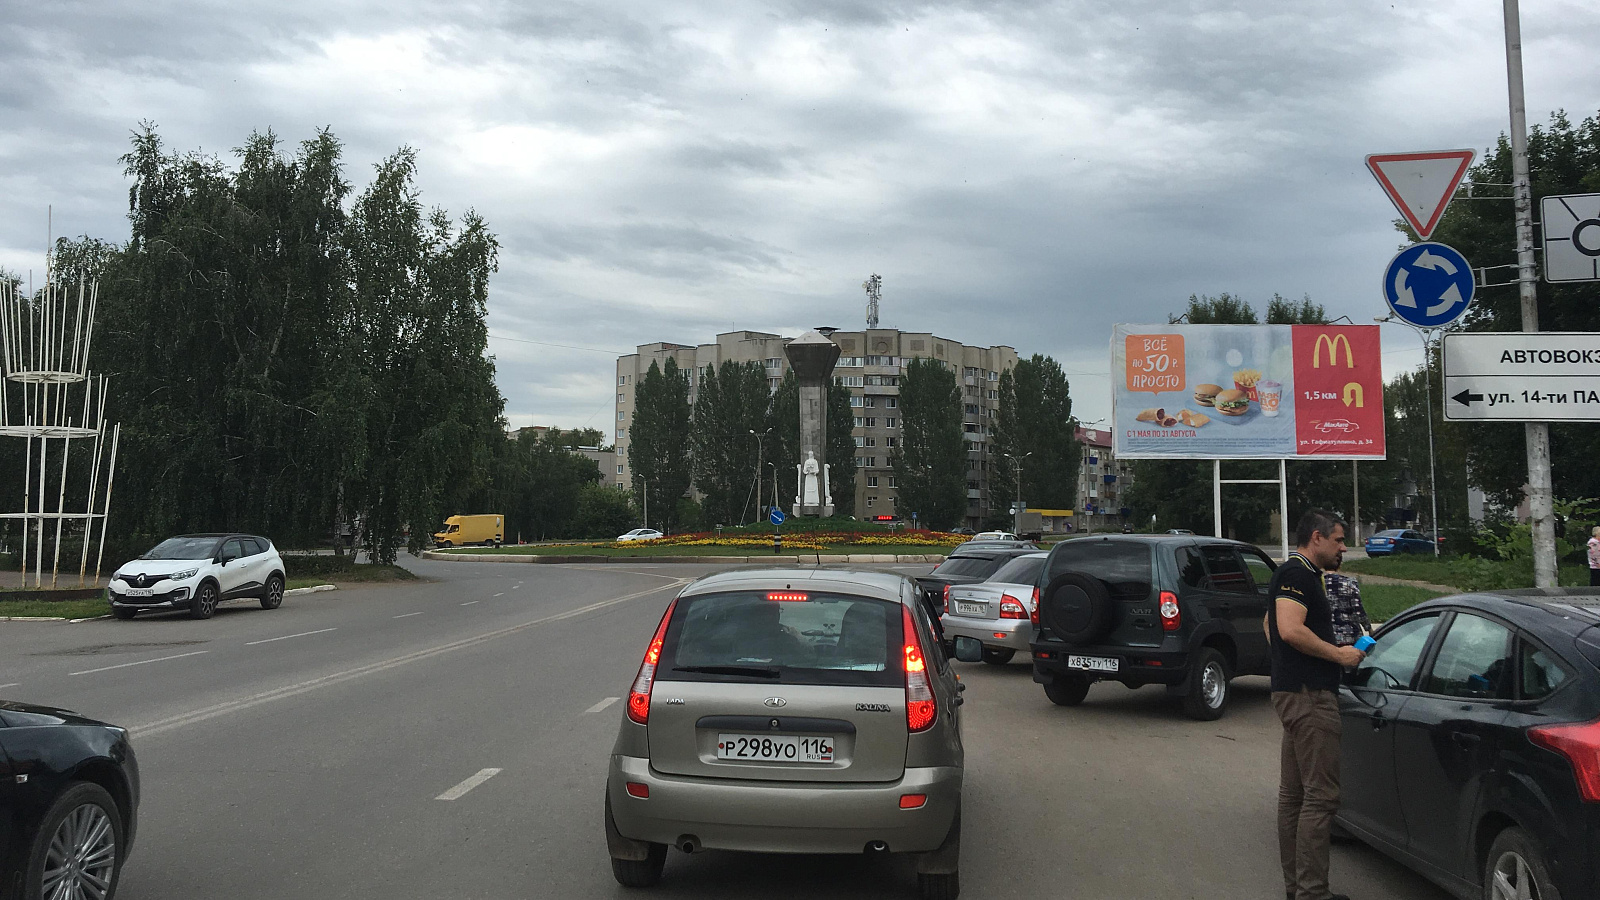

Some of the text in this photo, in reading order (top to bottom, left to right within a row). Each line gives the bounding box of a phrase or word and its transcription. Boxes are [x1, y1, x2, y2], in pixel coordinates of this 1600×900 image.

[1143, 336, 1168, 352] ВСЁ
[1132, 358, 1143, 368] ПО
[1142, 353, 1170, 372] 50
[1500, 349, 1600, 364] АВТОВОКЗ
[1132, 374, 1180, 388] ПРОСТО
[1304, 390, 1320, 401] 1,5
[1488, 390, 1600, 406] ул. 14-ти ПА
[1127, 430, 1132, 438] С
[1137, 430, 1151, 438] МАЯ
[1152, 430, 1161, 438] ПО
[1170, 430, 1197, 438] АВГУСТА
[1071, 657, 1117, 668] Х835ТУ 116
[666, 697, 685, 705] LADA
[856, 702, 891, 712] KALINA
[725, 737, 829, 759] Р298УО 116
